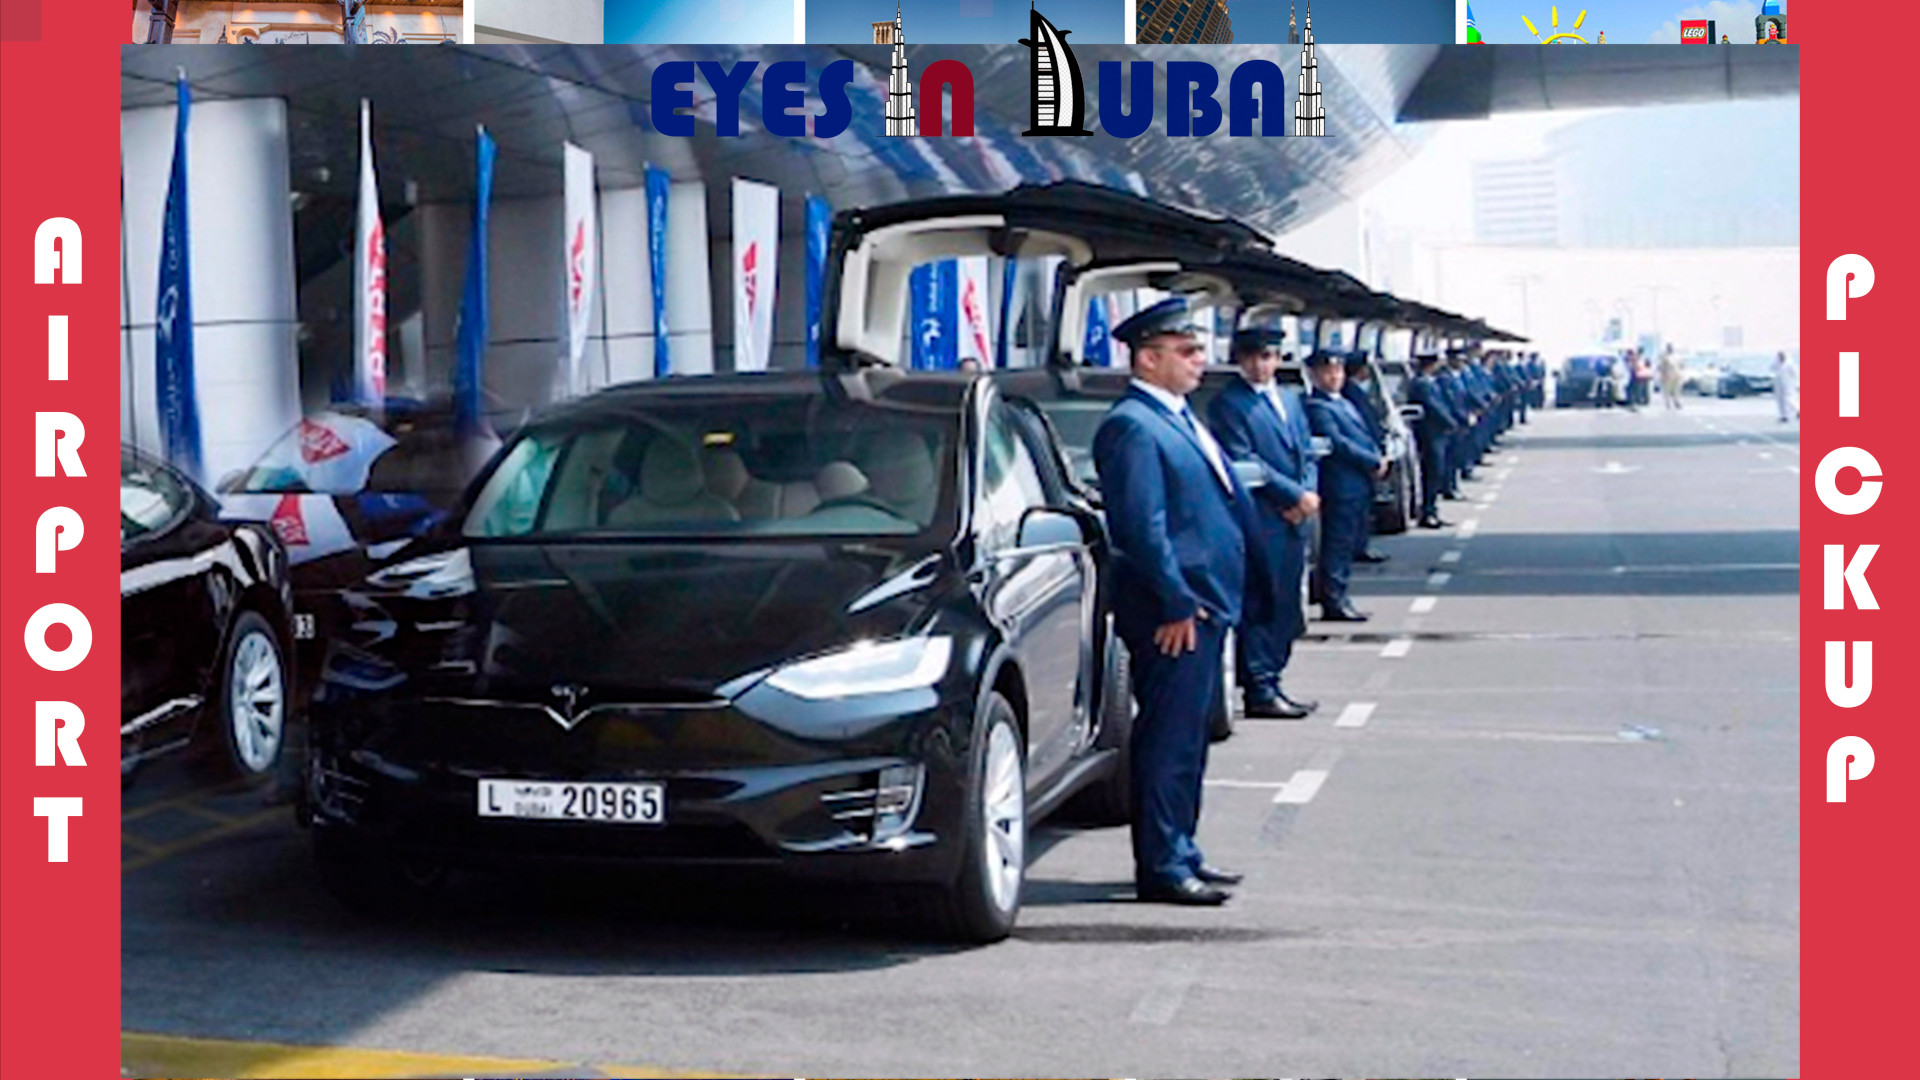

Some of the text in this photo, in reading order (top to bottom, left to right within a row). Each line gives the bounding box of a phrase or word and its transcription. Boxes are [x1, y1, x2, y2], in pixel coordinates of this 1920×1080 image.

[1682, 27, 1706, 38] LEGO
[488, 784, 501, 812] L
[563, 786, 658, 819] 20965
